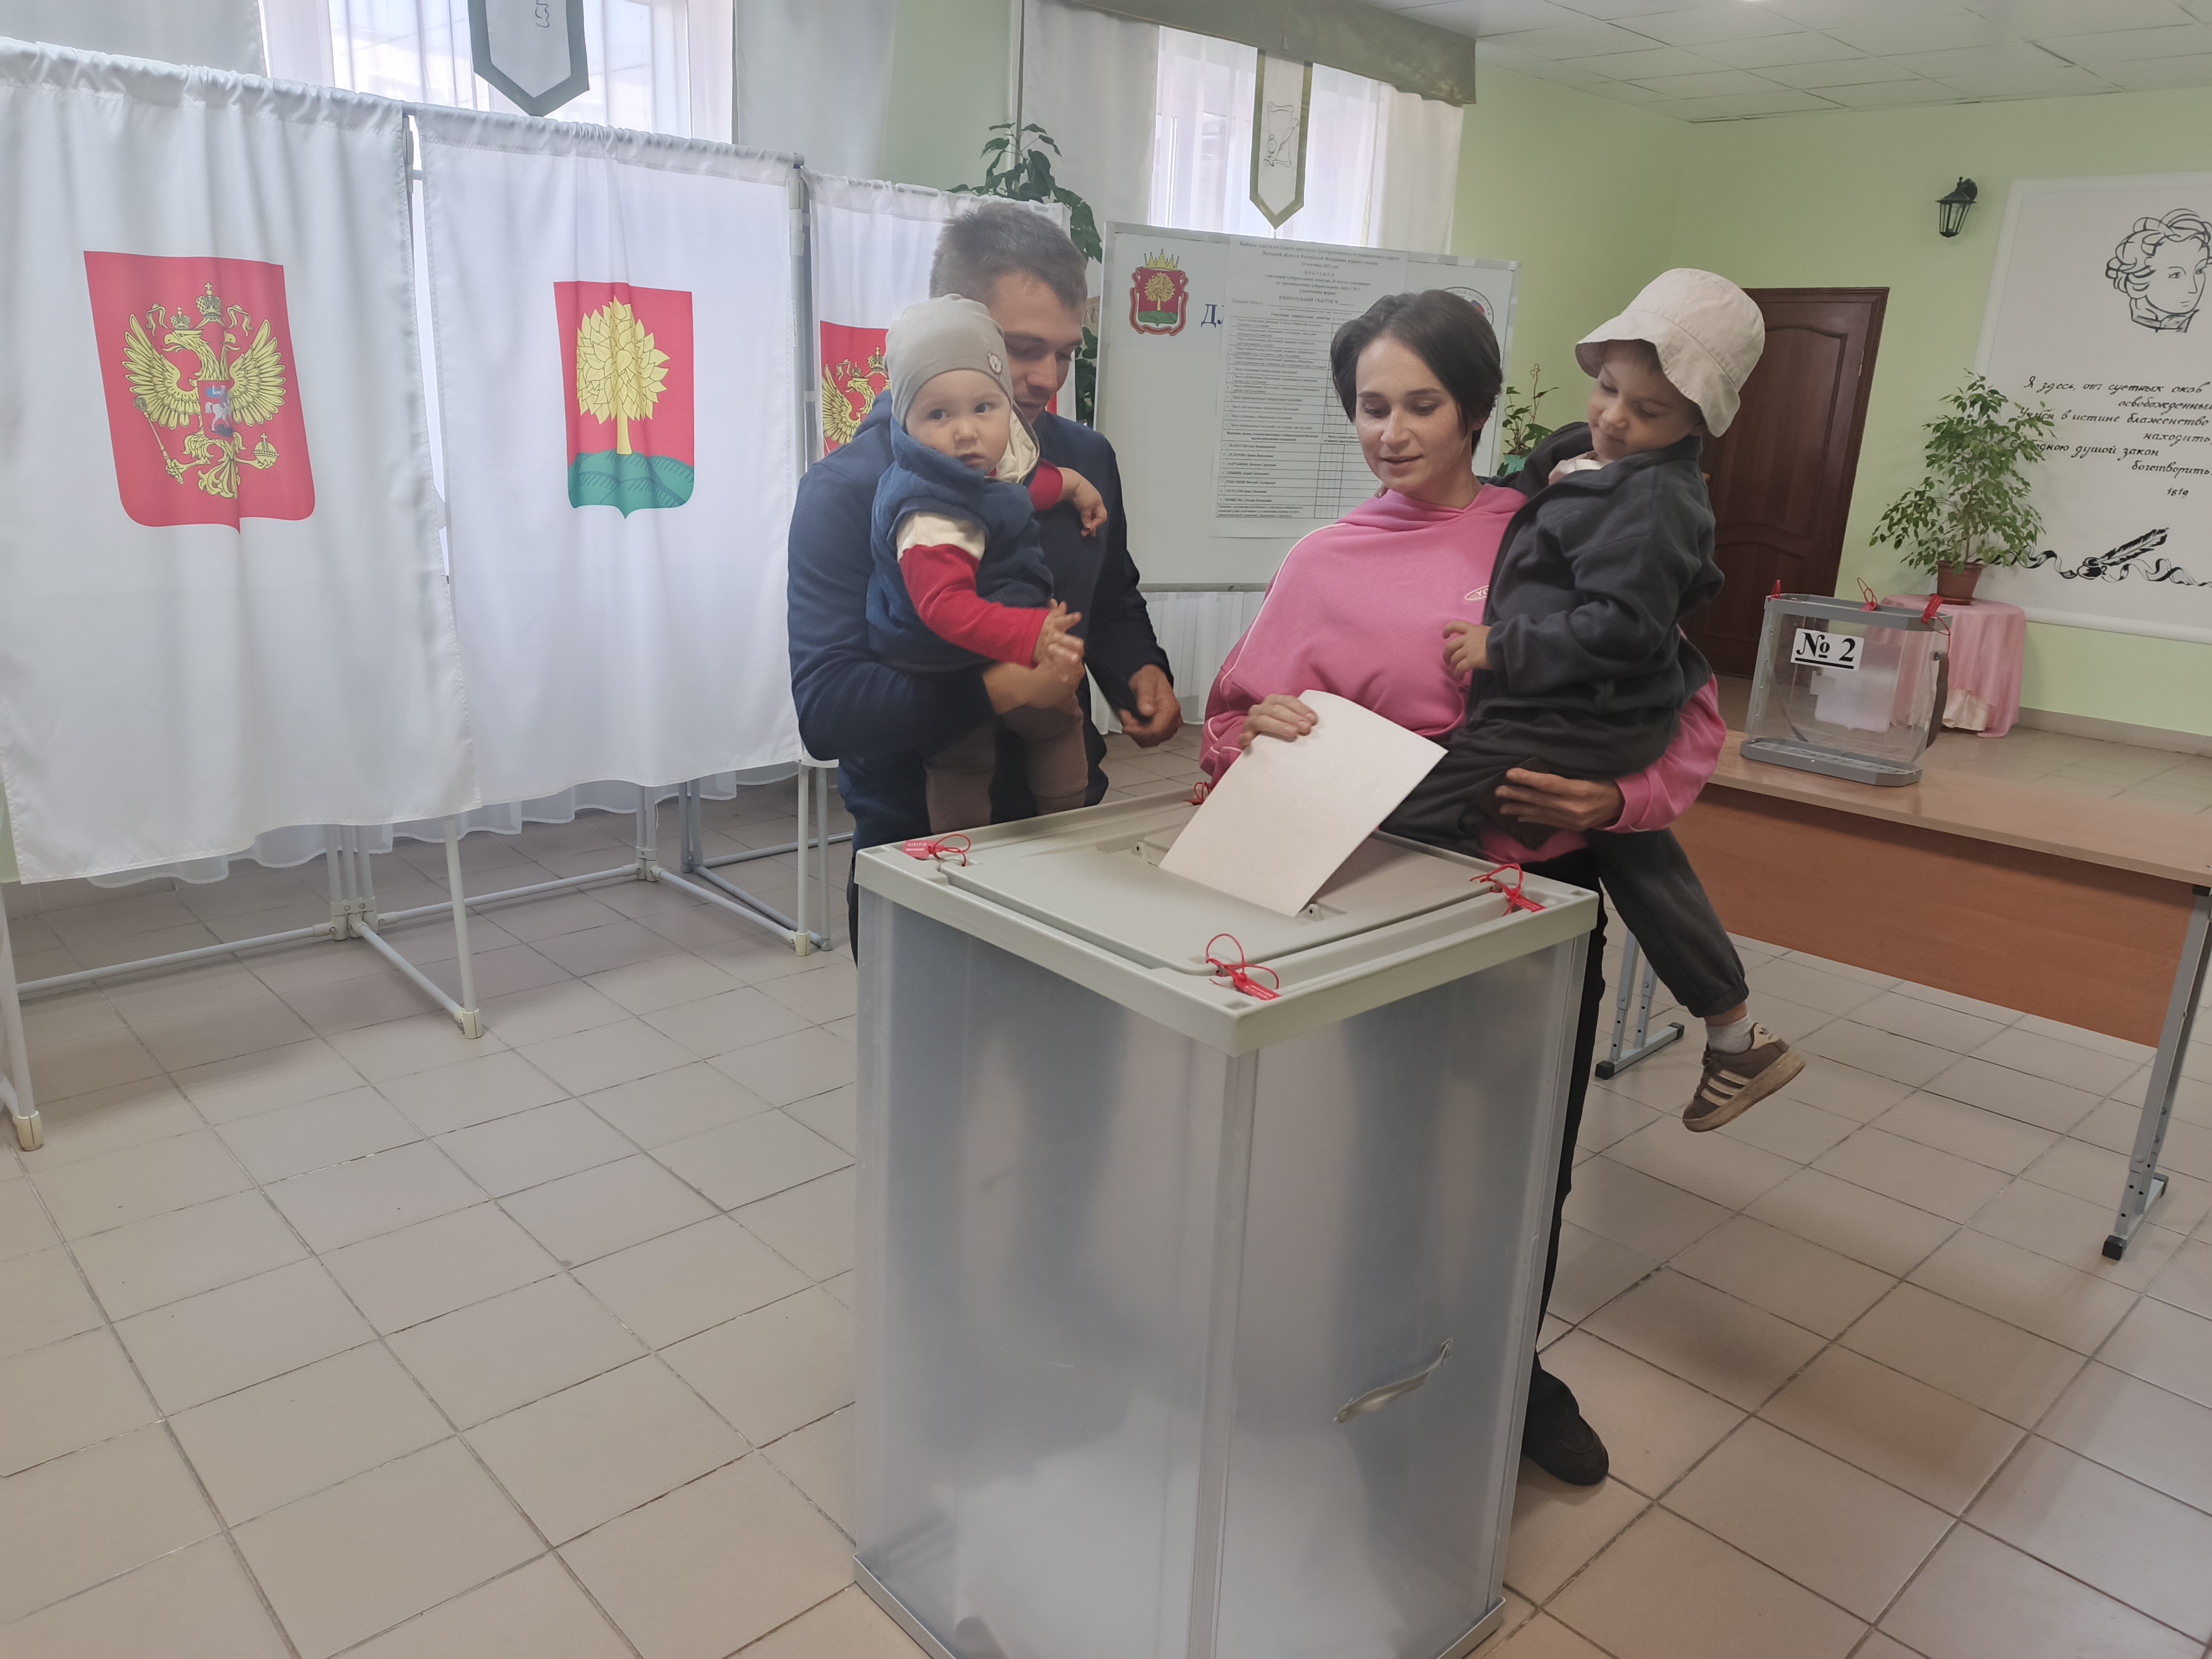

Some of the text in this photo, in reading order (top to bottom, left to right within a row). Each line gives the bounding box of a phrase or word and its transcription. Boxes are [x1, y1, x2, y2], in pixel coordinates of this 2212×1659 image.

[2023, 376, 2036, 389] Я
[2036, 382, 2076, 395] здесь,
[2108, 384, 2165, 395] суетных
[2171, 381, 2211, 394] оков
[2118, 396, 2212, 416] освобожденны
[2061, 410, 2072, 420] в
[2072, 414, 2121, 423] истине
[2127, 413, 2209, 426] блаженство
[2070, 445, 2117, 459] душой
[2117, 447, 2159, 461] закон
[2166, 487, 2189, 499] 1819
[1796, 632, 1856, 662] № 2
